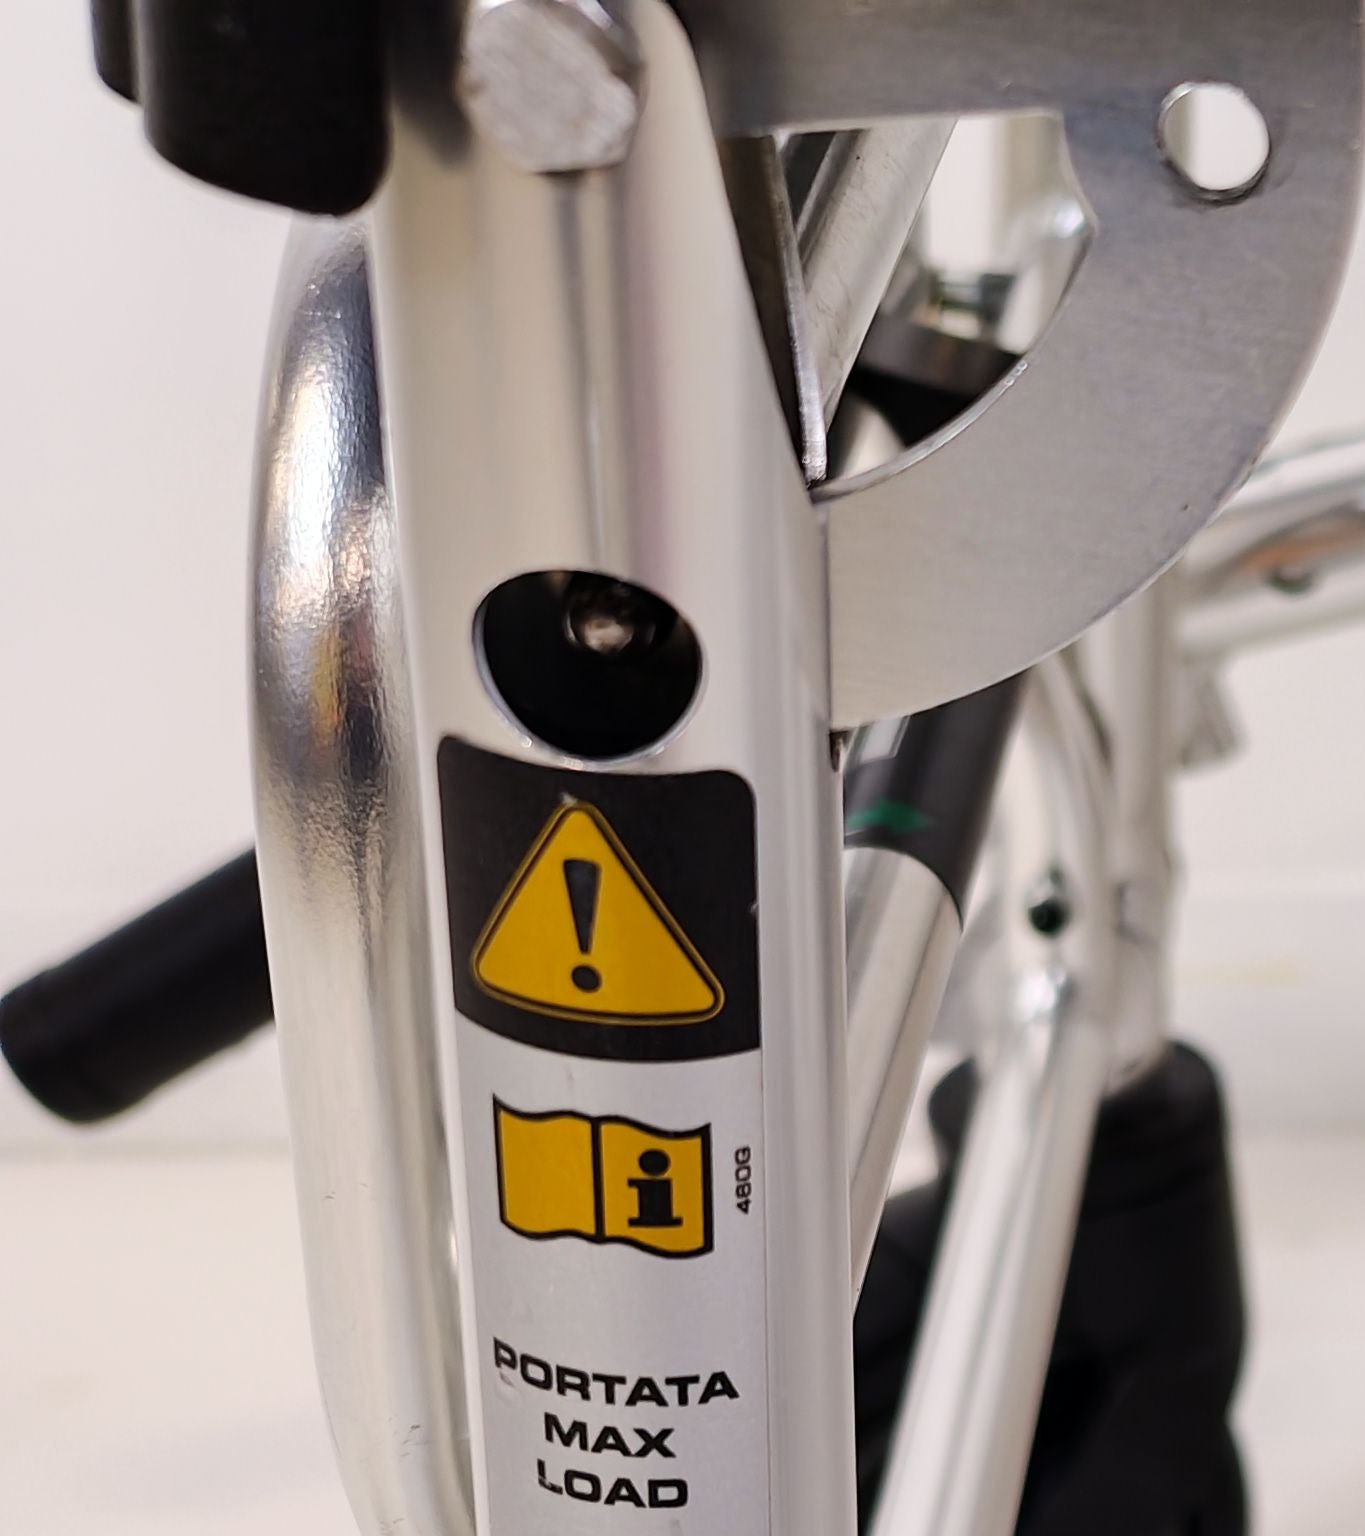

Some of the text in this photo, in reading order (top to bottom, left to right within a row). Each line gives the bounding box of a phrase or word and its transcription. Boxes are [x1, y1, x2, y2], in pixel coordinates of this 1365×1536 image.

[735, 1146, 752, 1214] 480G
[493, 1336, 740, 1407] PORTATA
[544, 1411, 677, 1458] MAX
[537, 1458, 688, 1508] LOAD
